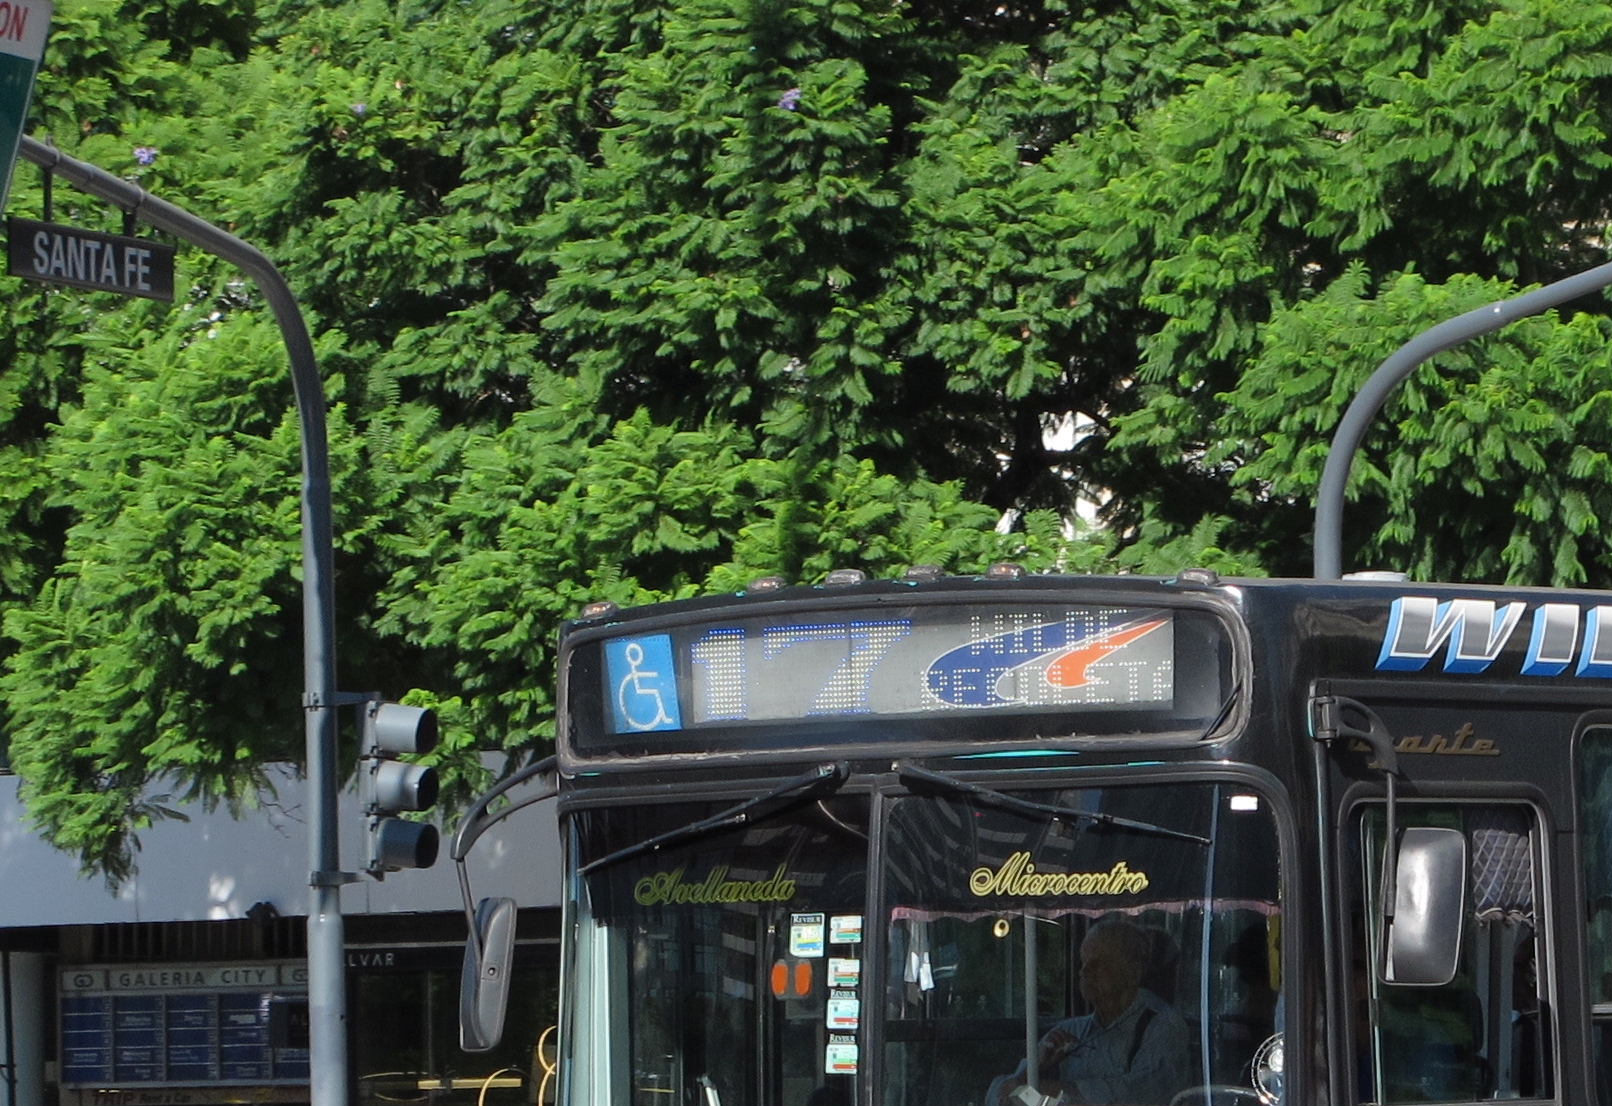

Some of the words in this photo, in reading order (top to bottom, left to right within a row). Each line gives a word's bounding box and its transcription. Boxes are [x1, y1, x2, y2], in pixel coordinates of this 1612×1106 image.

[33, 230, 117, 286] SANTA
[124, 246, 151, 291] FE
[970, 609, 1128, 656] WILDE
[690, 619, 911, 719] 17
[634, 863, 795, 905] Avellaneda
[969, 851, 1149, 897] Microcentro
[119, 971, 205, 987] GALERIA
[221, 969, 266, 984] CITY
[344, 952, 395, 967] LVAR
